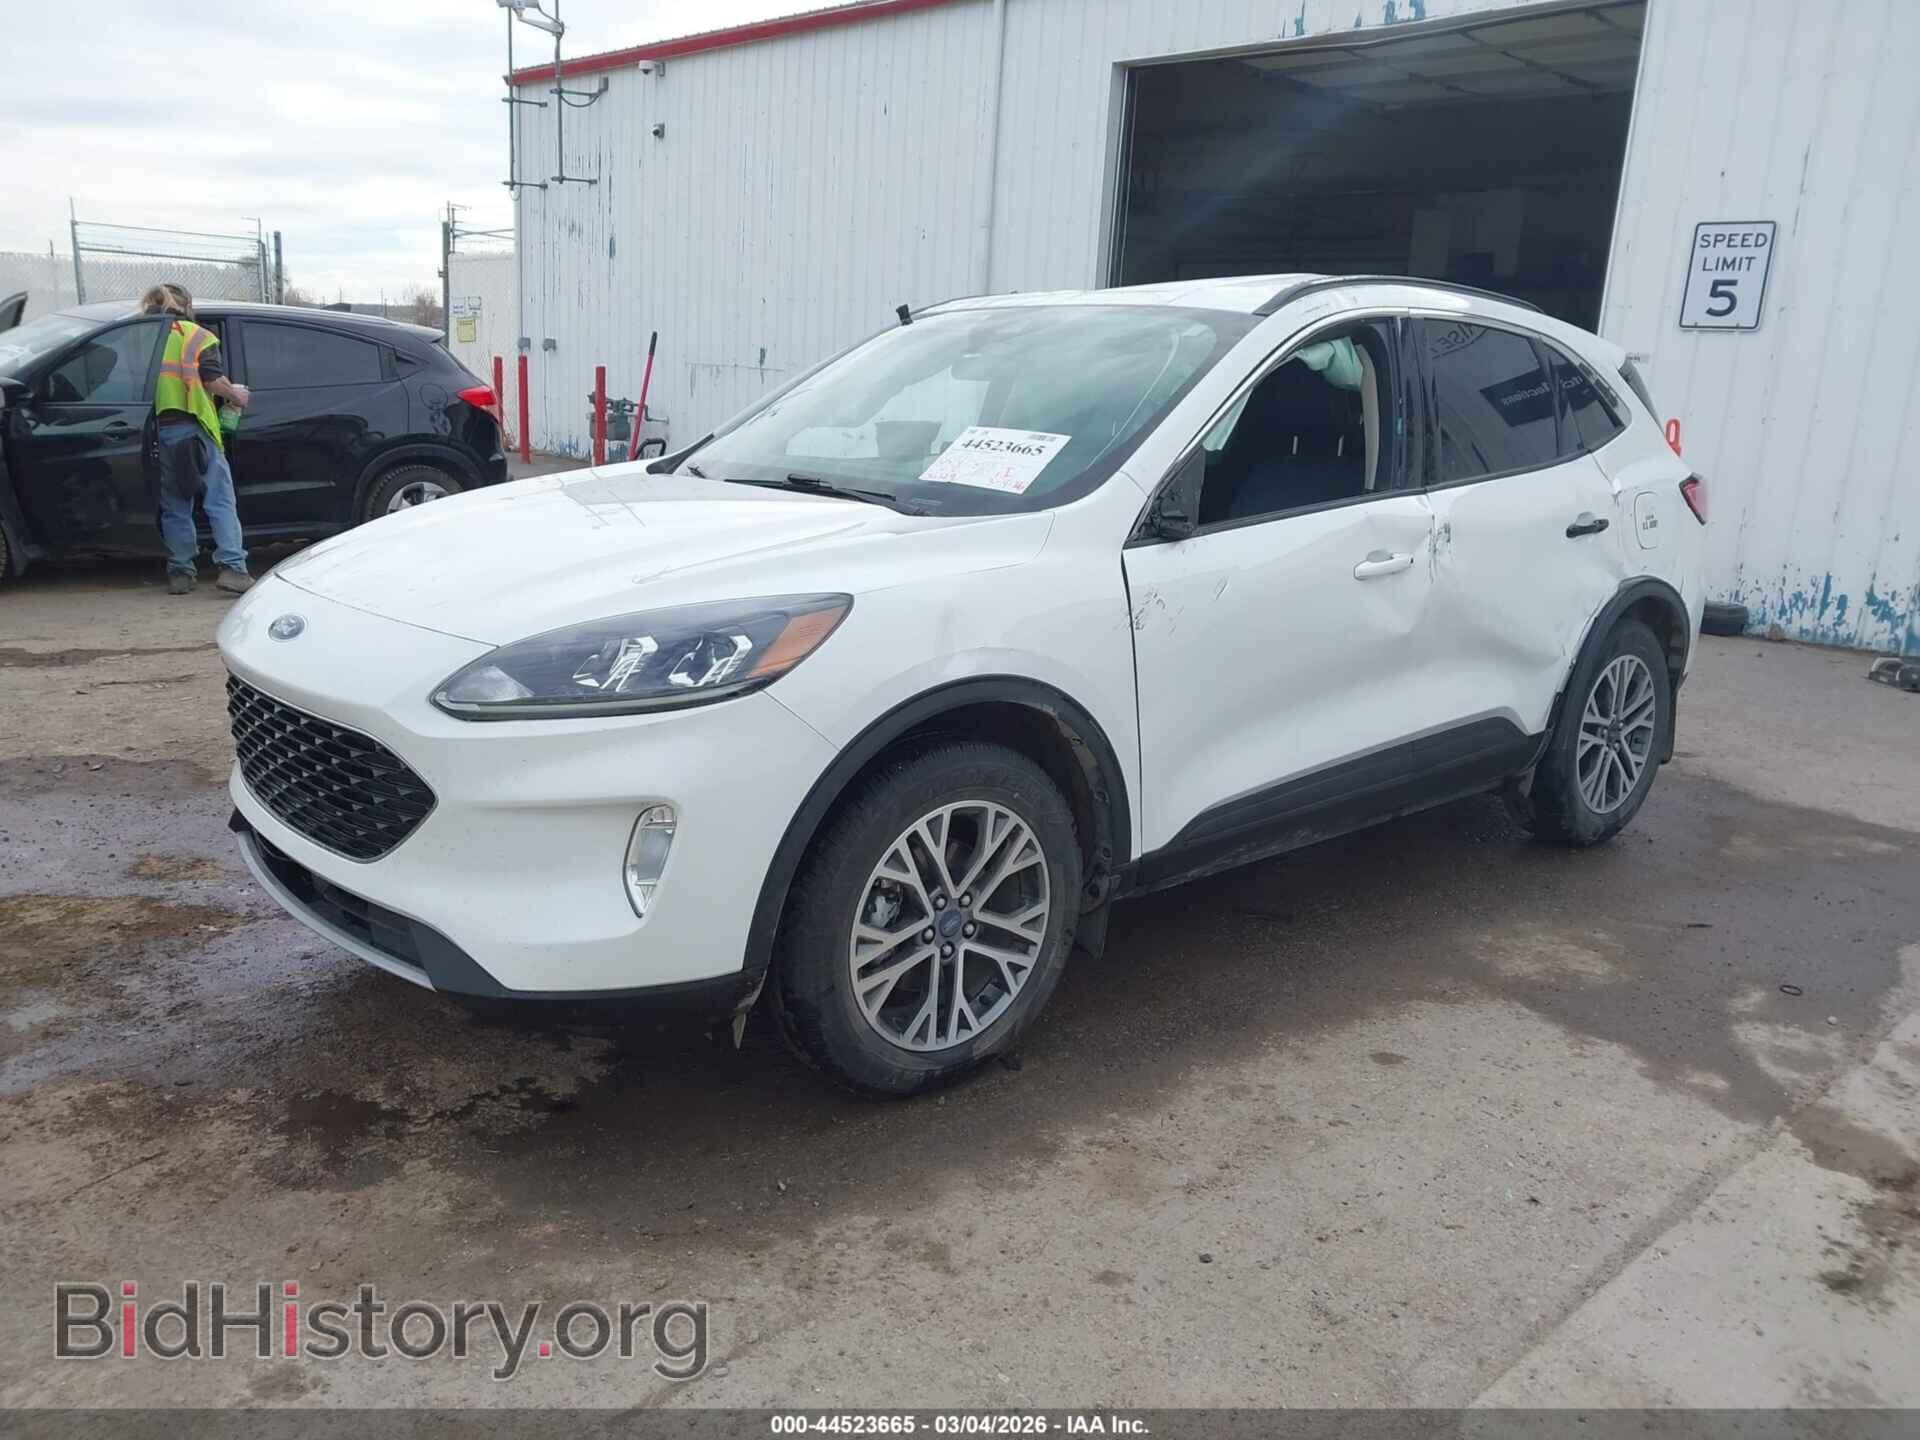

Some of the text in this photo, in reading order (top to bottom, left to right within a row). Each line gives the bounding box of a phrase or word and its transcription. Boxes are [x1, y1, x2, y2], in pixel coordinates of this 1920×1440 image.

[1699, 232, 1768, 249] SPEED
[1701, 256, 1756, 272] LIMIT
[1704, 278, 1739, 317] 5
[961, 438, 1047, 457] 44523665
